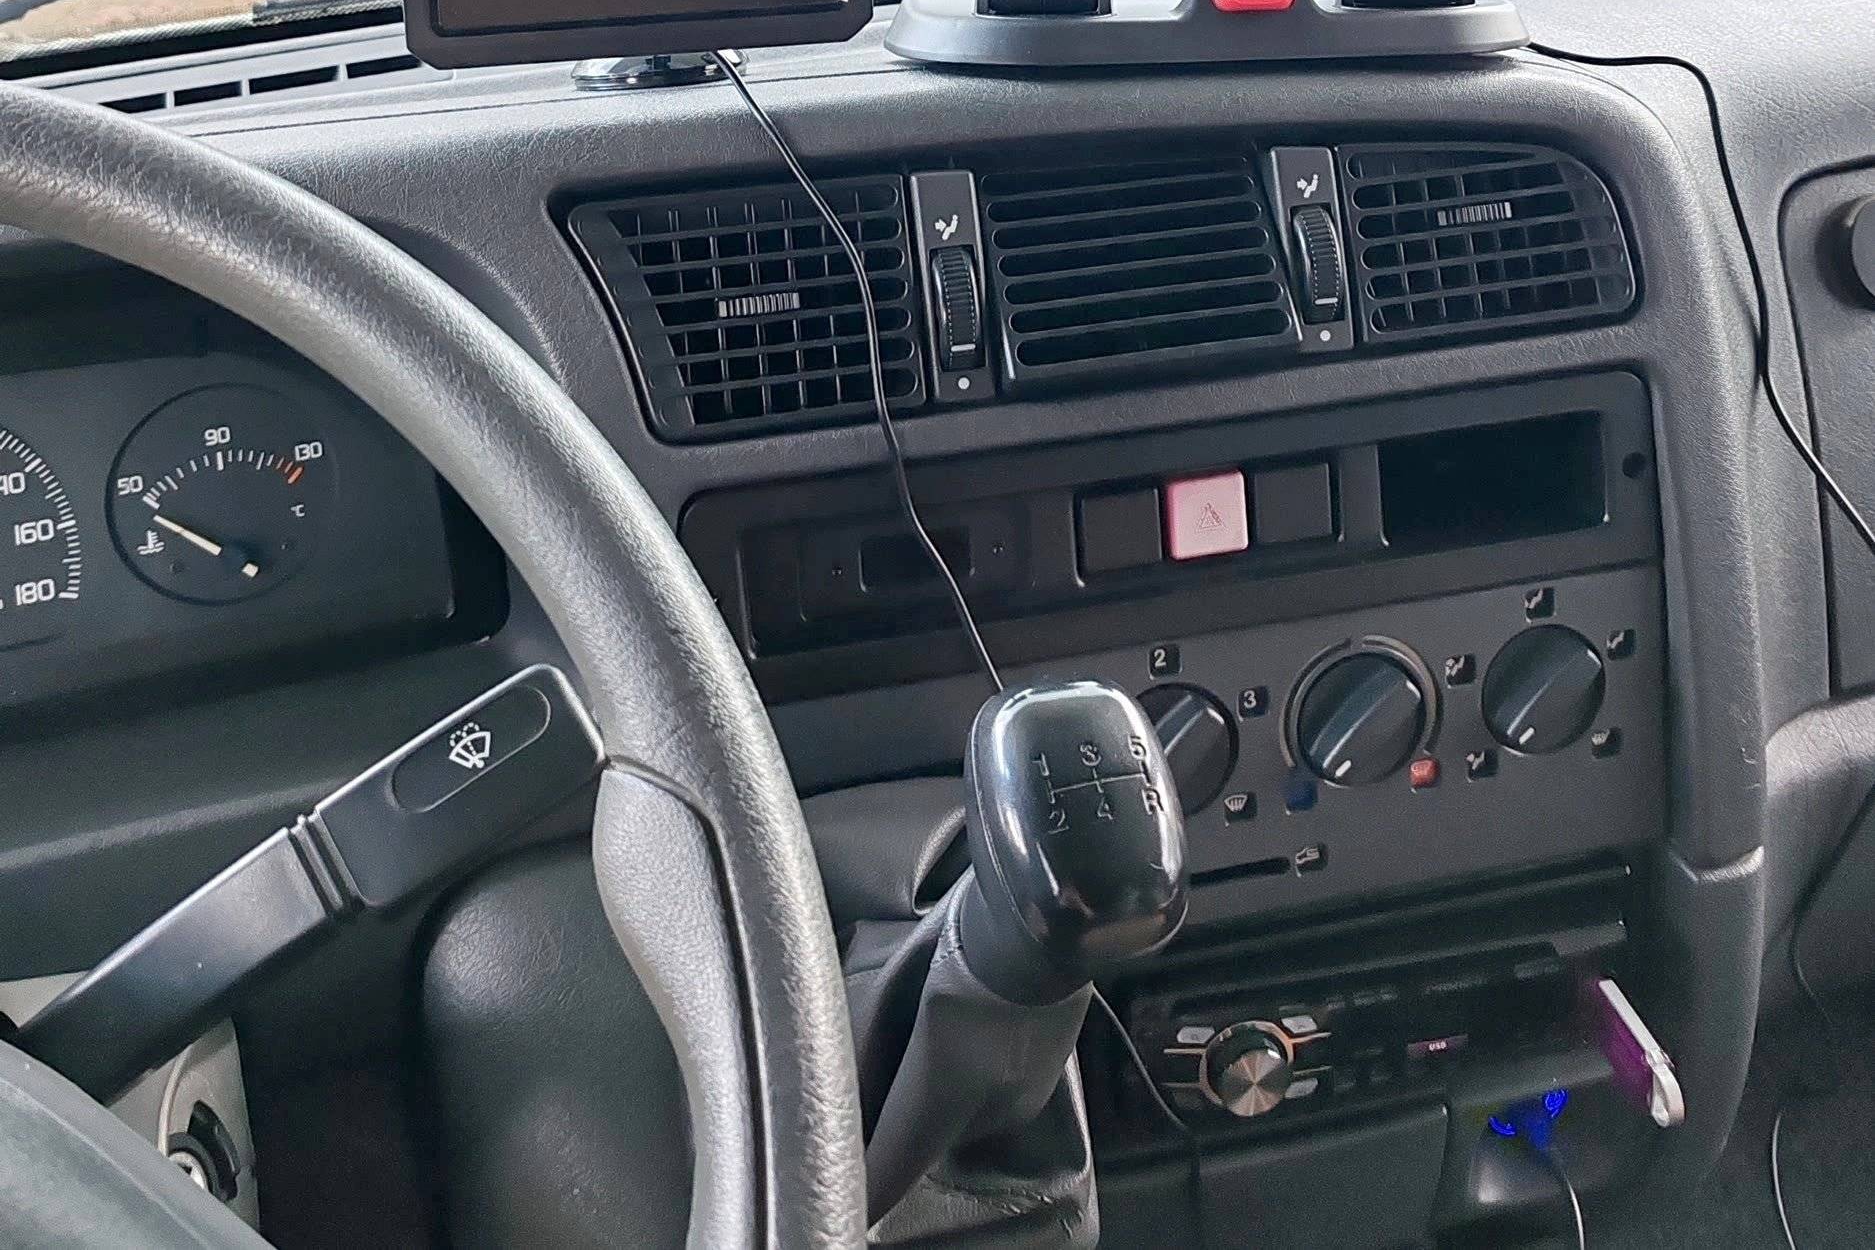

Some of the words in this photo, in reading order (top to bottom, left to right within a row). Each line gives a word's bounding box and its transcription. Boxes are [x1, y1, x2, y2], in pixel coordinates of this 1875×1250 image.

[204, 426, 231, 447] 90
[294, 441, 323, 462] 130
[117, 475, 143, 496] 50
[14, 518, 55, 546] 160
[15, 578, 56, 606] 180
[1153, 648, 1167, 668] 2
[1243, 690, 1257, 709] 3
[1032, 752, 1050, 777] 1
[1128, 735, 1147, 760] 5
[1049, 808, 1070, 835] 2
[1097, 798, 1114, 821] 4
[1141, 787, 1165, 815] R
